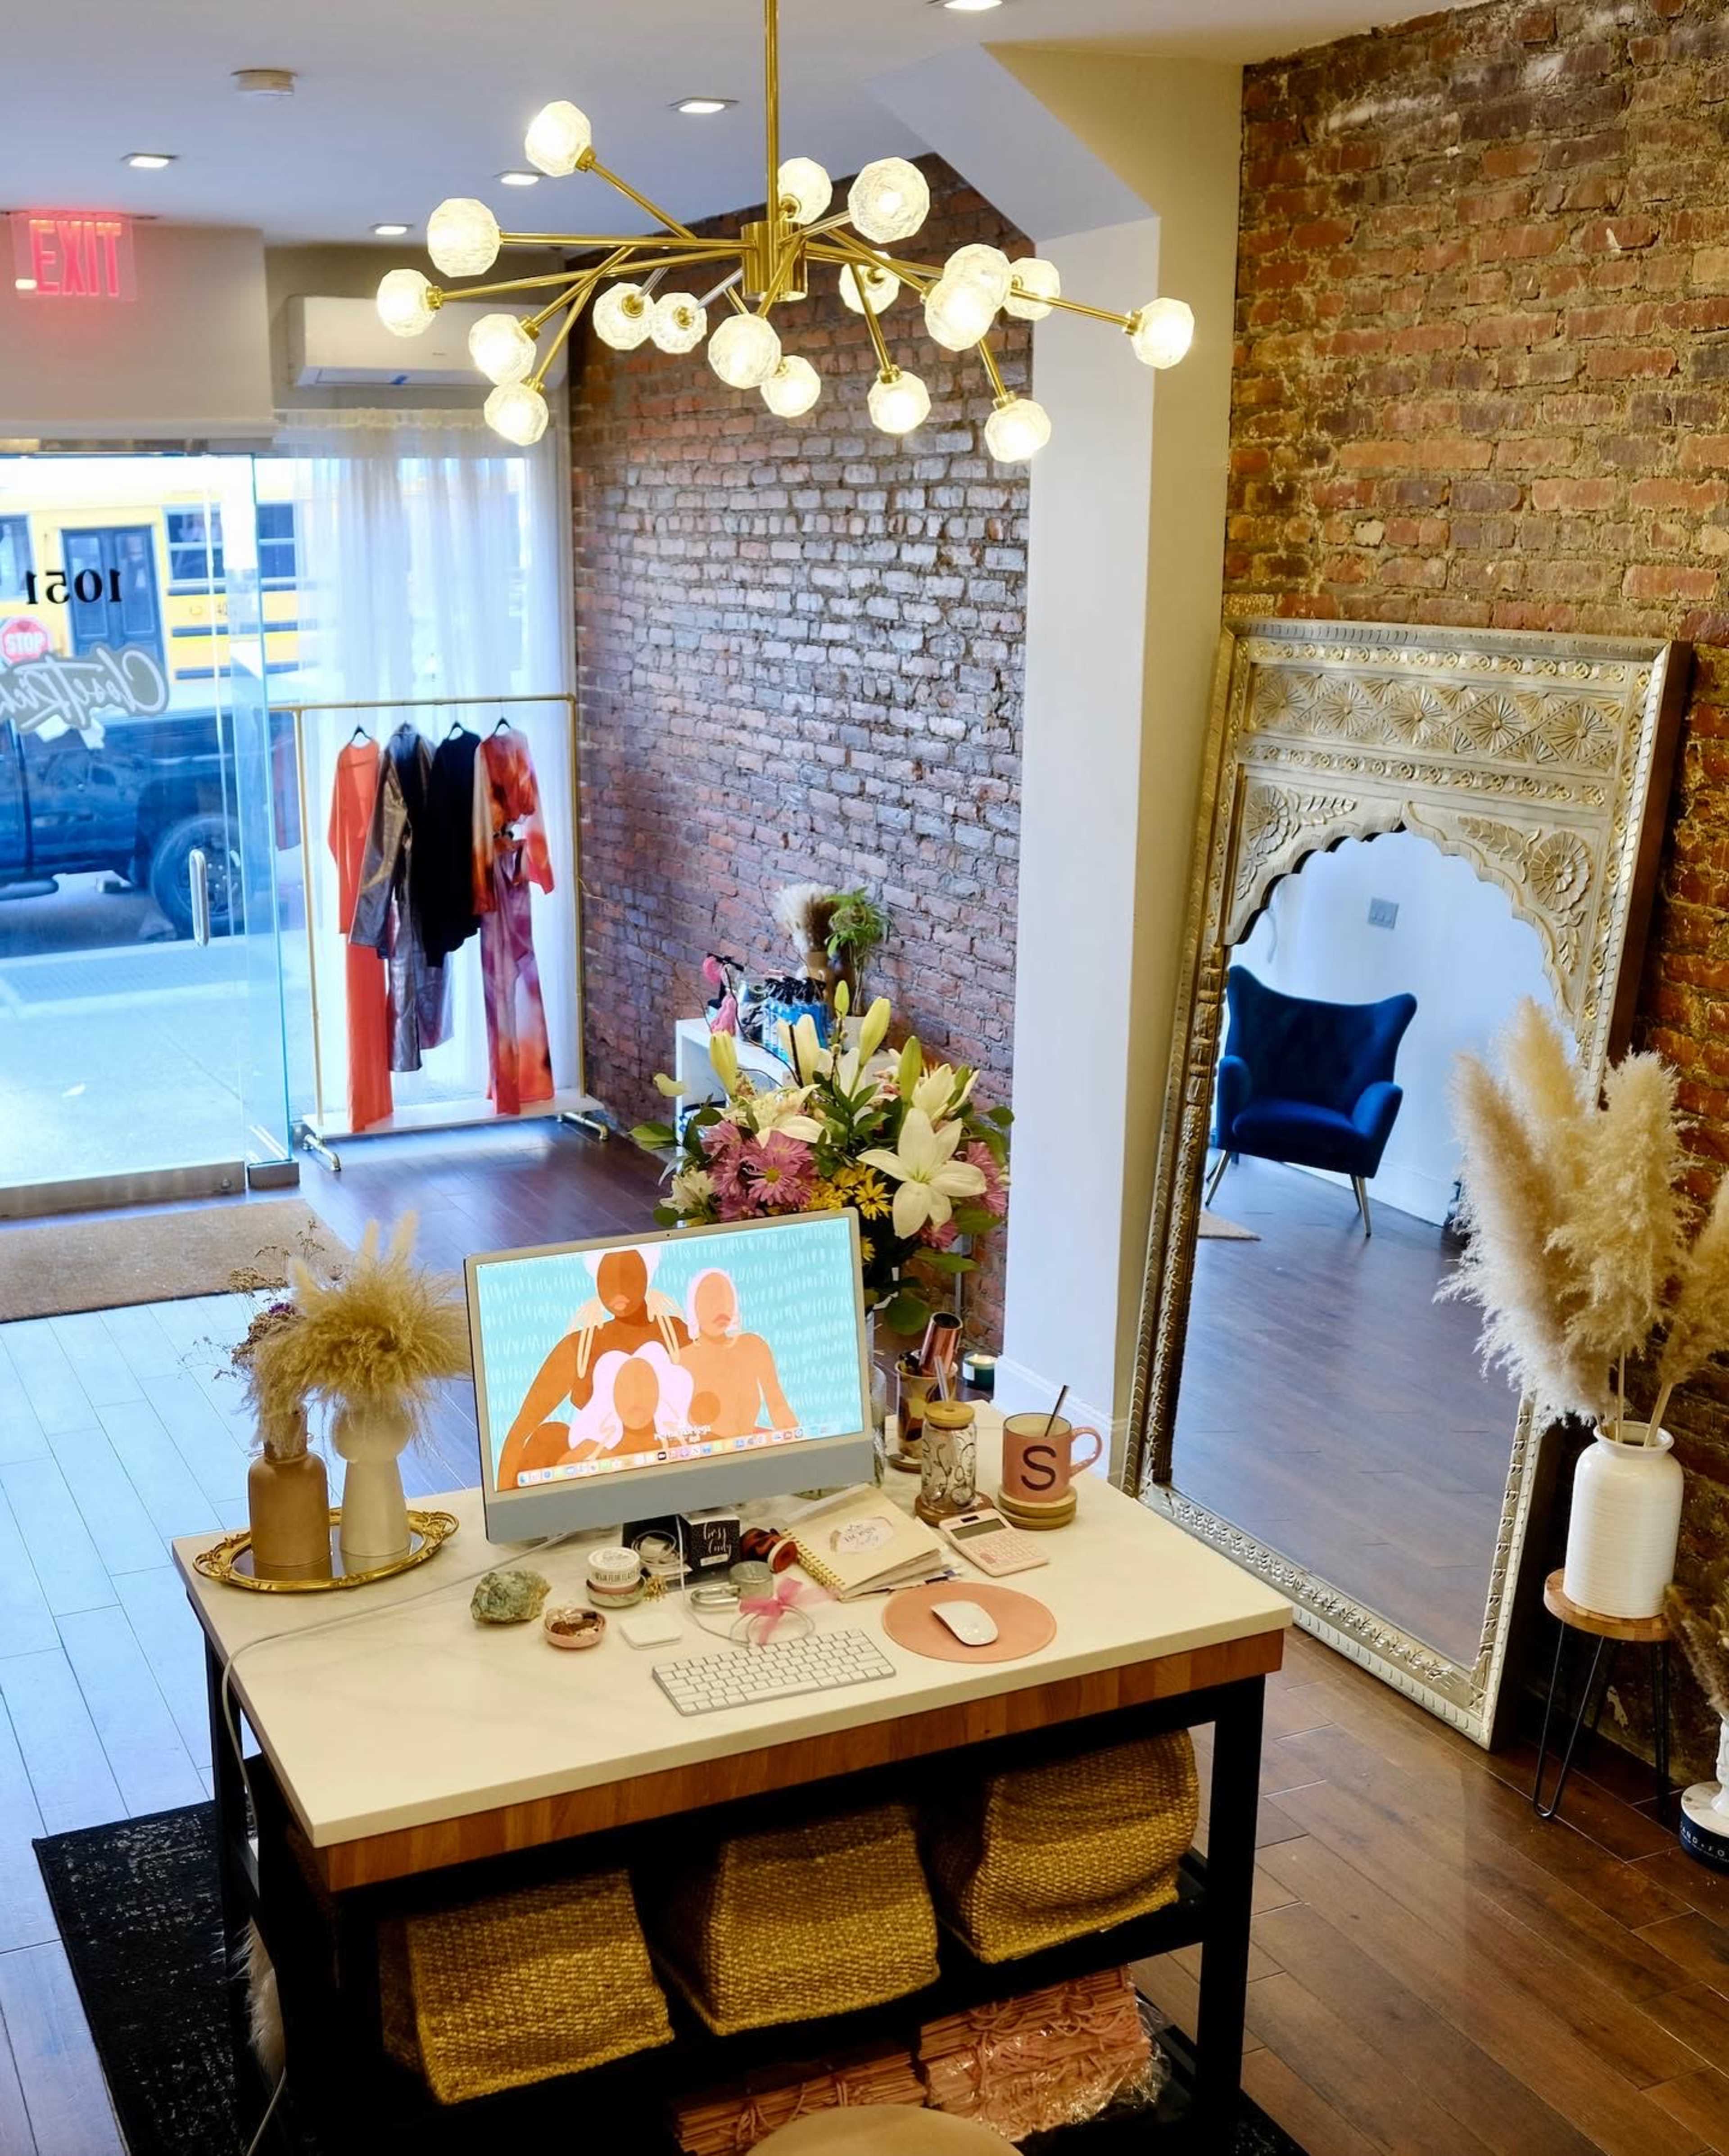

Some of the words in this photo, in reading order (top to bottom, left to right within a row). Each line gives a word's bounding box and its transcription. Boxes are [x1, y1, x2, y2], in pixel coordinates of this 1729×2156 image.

[29, 219, 122, 297] EXIT
[6, 633, 44, 653] STOP
[1020, 1445, 1057, 1491] S
